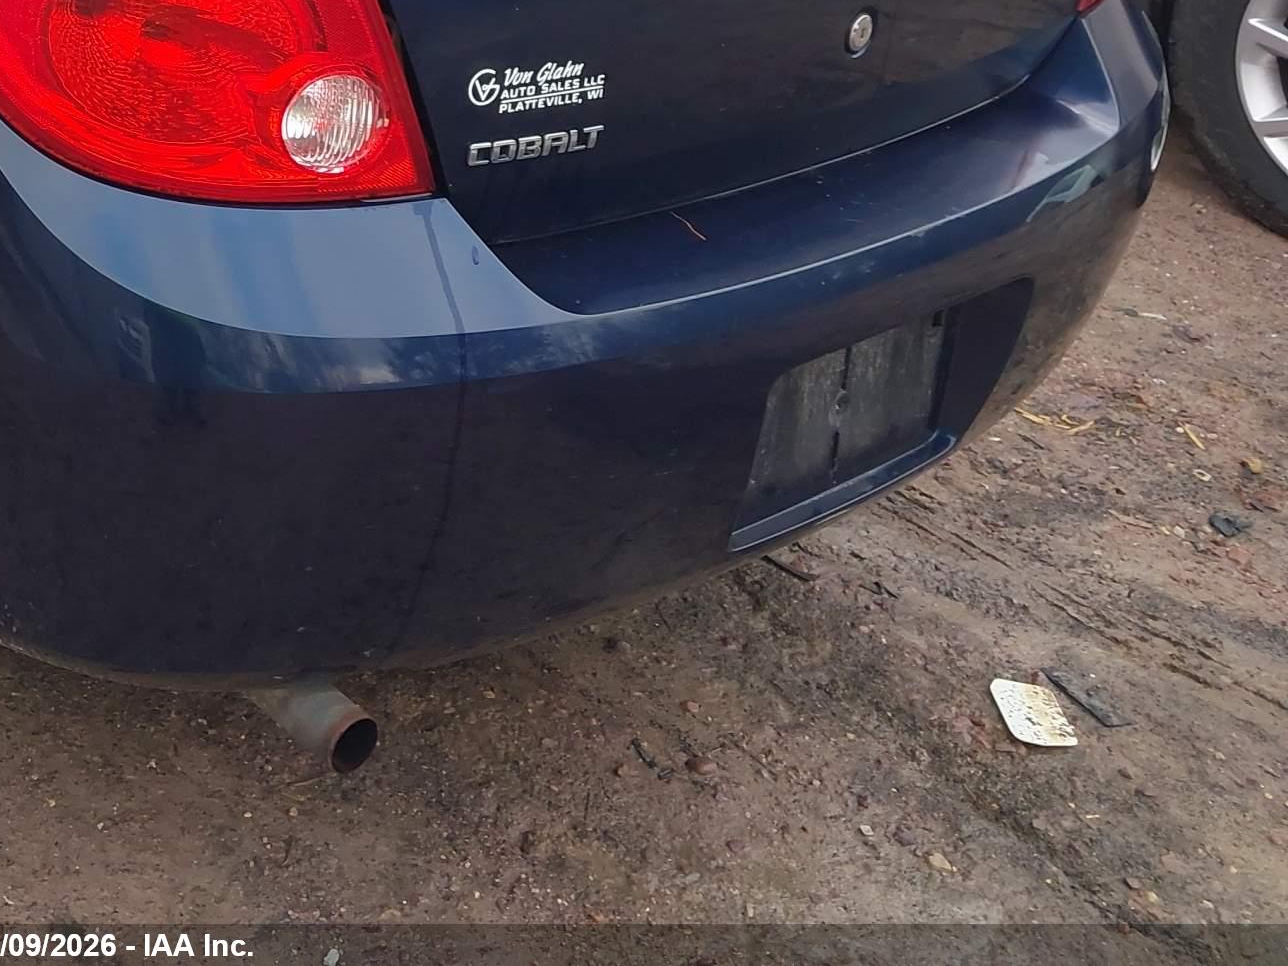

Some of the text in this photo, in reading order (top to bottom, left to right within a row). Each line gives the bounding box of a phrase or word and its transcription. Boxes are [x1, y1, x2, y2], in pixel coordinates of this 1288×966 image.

[504, 60, 584, 85] Von Glahn
[500, 74, 605, 99] AUTO SALES LLC
[499, 88, 604, 113] PLATTEVILLE, WI
[468, 125, 605, 167] COBALT
